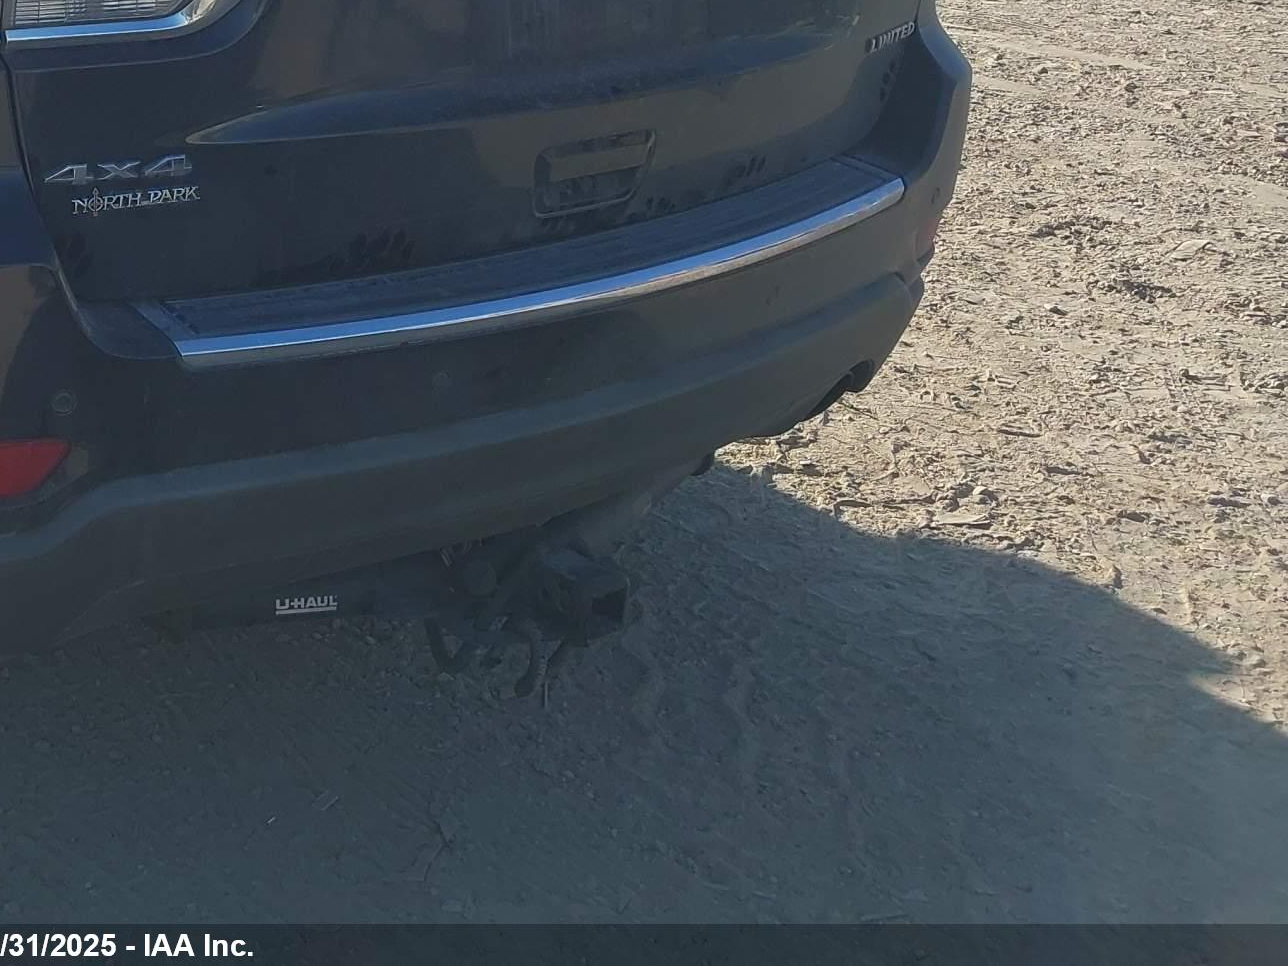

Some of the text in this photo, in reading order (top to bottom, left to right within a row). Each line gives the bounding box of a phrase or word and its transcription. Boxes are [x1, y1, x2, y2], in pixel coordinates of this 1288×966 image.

[870, 22, 915, 54] LIMITED
[72, 186, 201, 215] NORTH PARK
[275, 595, 338, 610] U-HAUL
